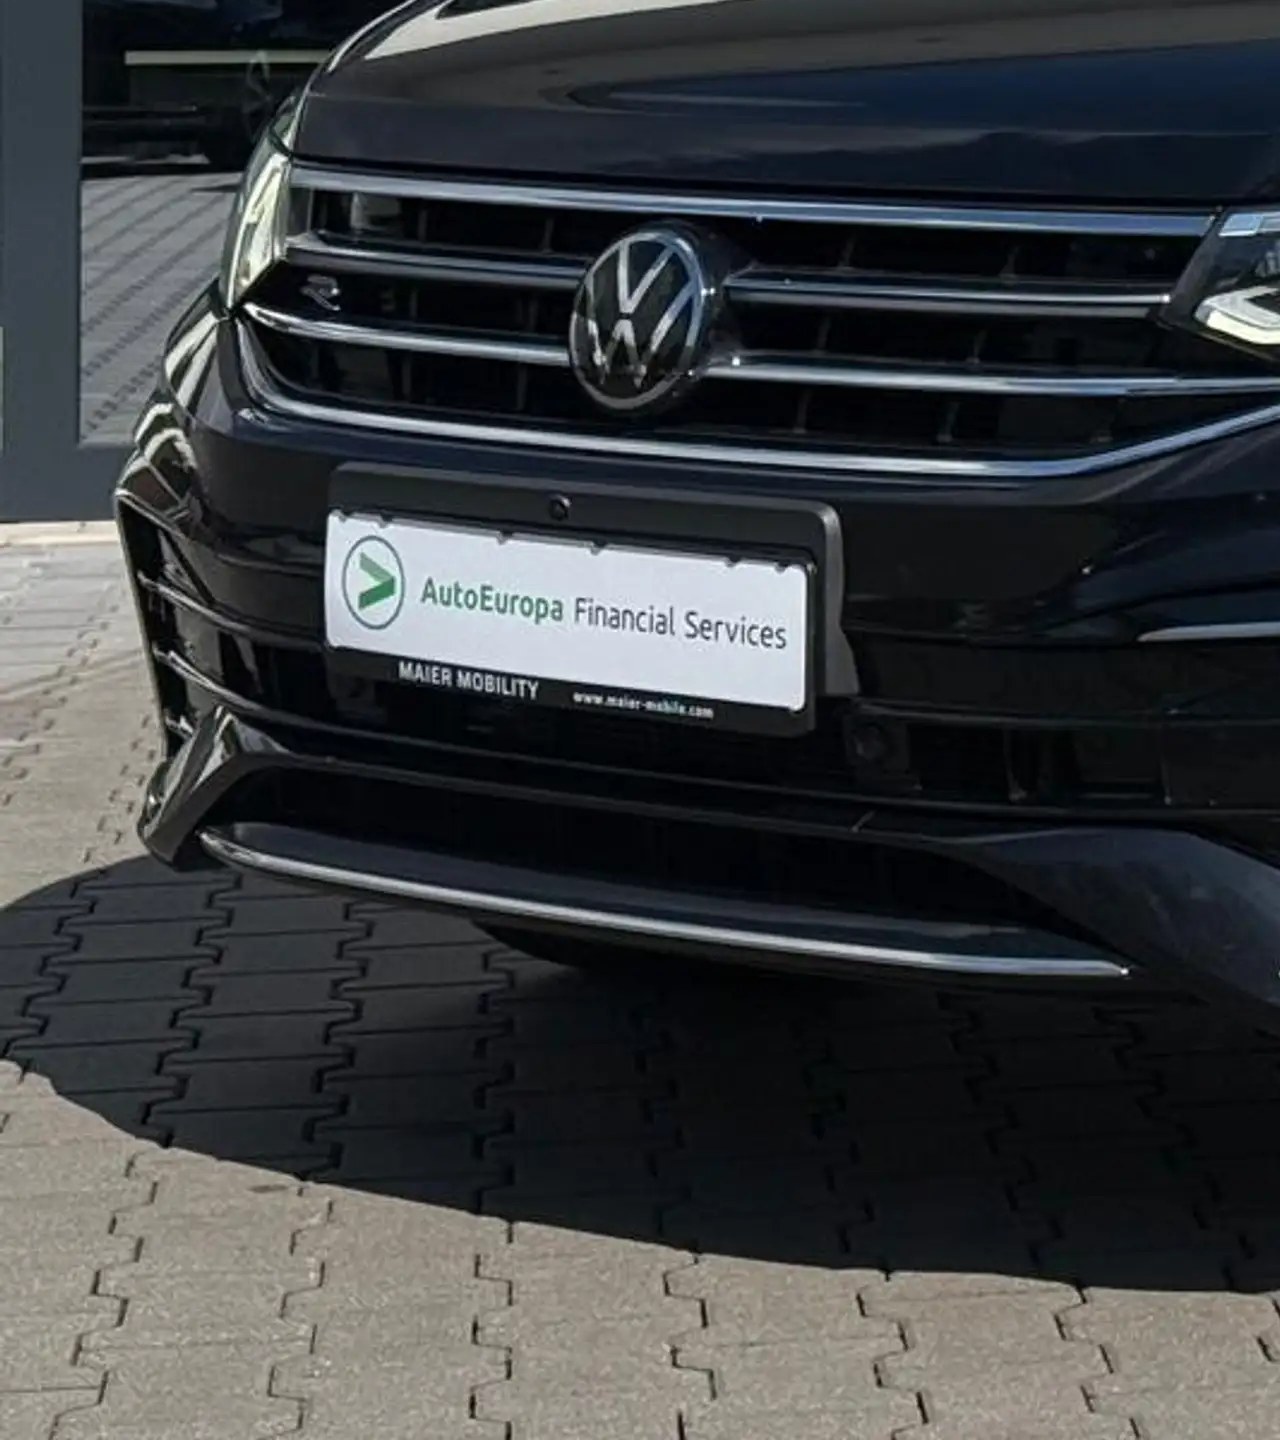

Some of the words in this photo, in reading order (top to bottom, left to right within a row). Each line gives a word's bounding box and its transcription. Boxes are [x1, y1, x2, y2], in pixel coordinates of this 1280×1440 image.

[420, 577, 563, 625] AutoEuropa
[574, 597, 676, 636] Financial
[684, 611, 787, 651] Services
[398, 661, 452, 688] MAIER
[455, 669, 540, 701] MOBILITY
